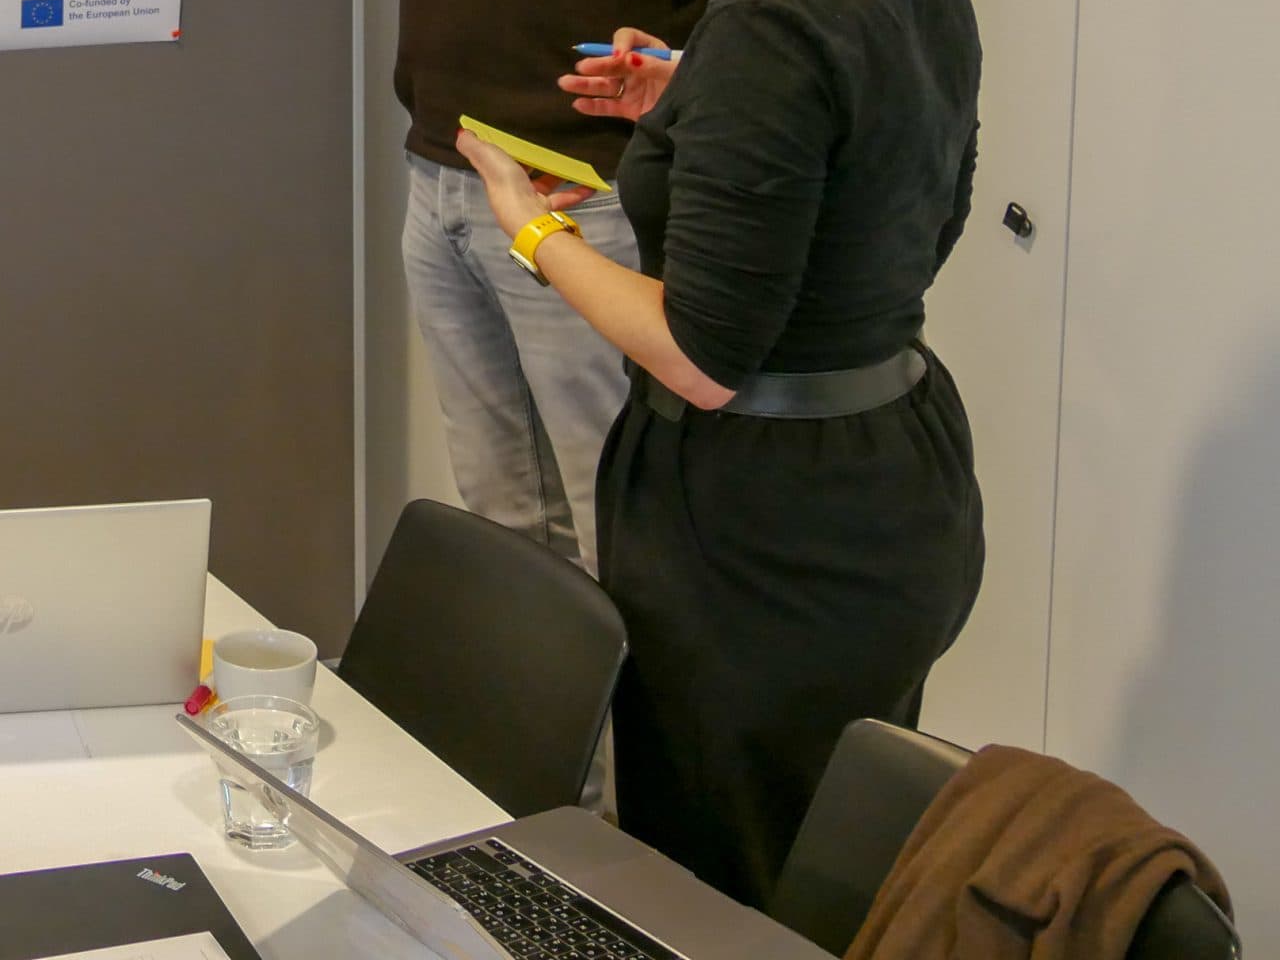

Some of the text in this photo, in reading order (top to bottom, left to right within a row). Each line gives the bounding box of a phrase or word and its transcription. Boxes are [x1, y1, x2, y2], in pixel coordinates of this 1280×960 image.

[69, 7, 160, 21] the European Union
